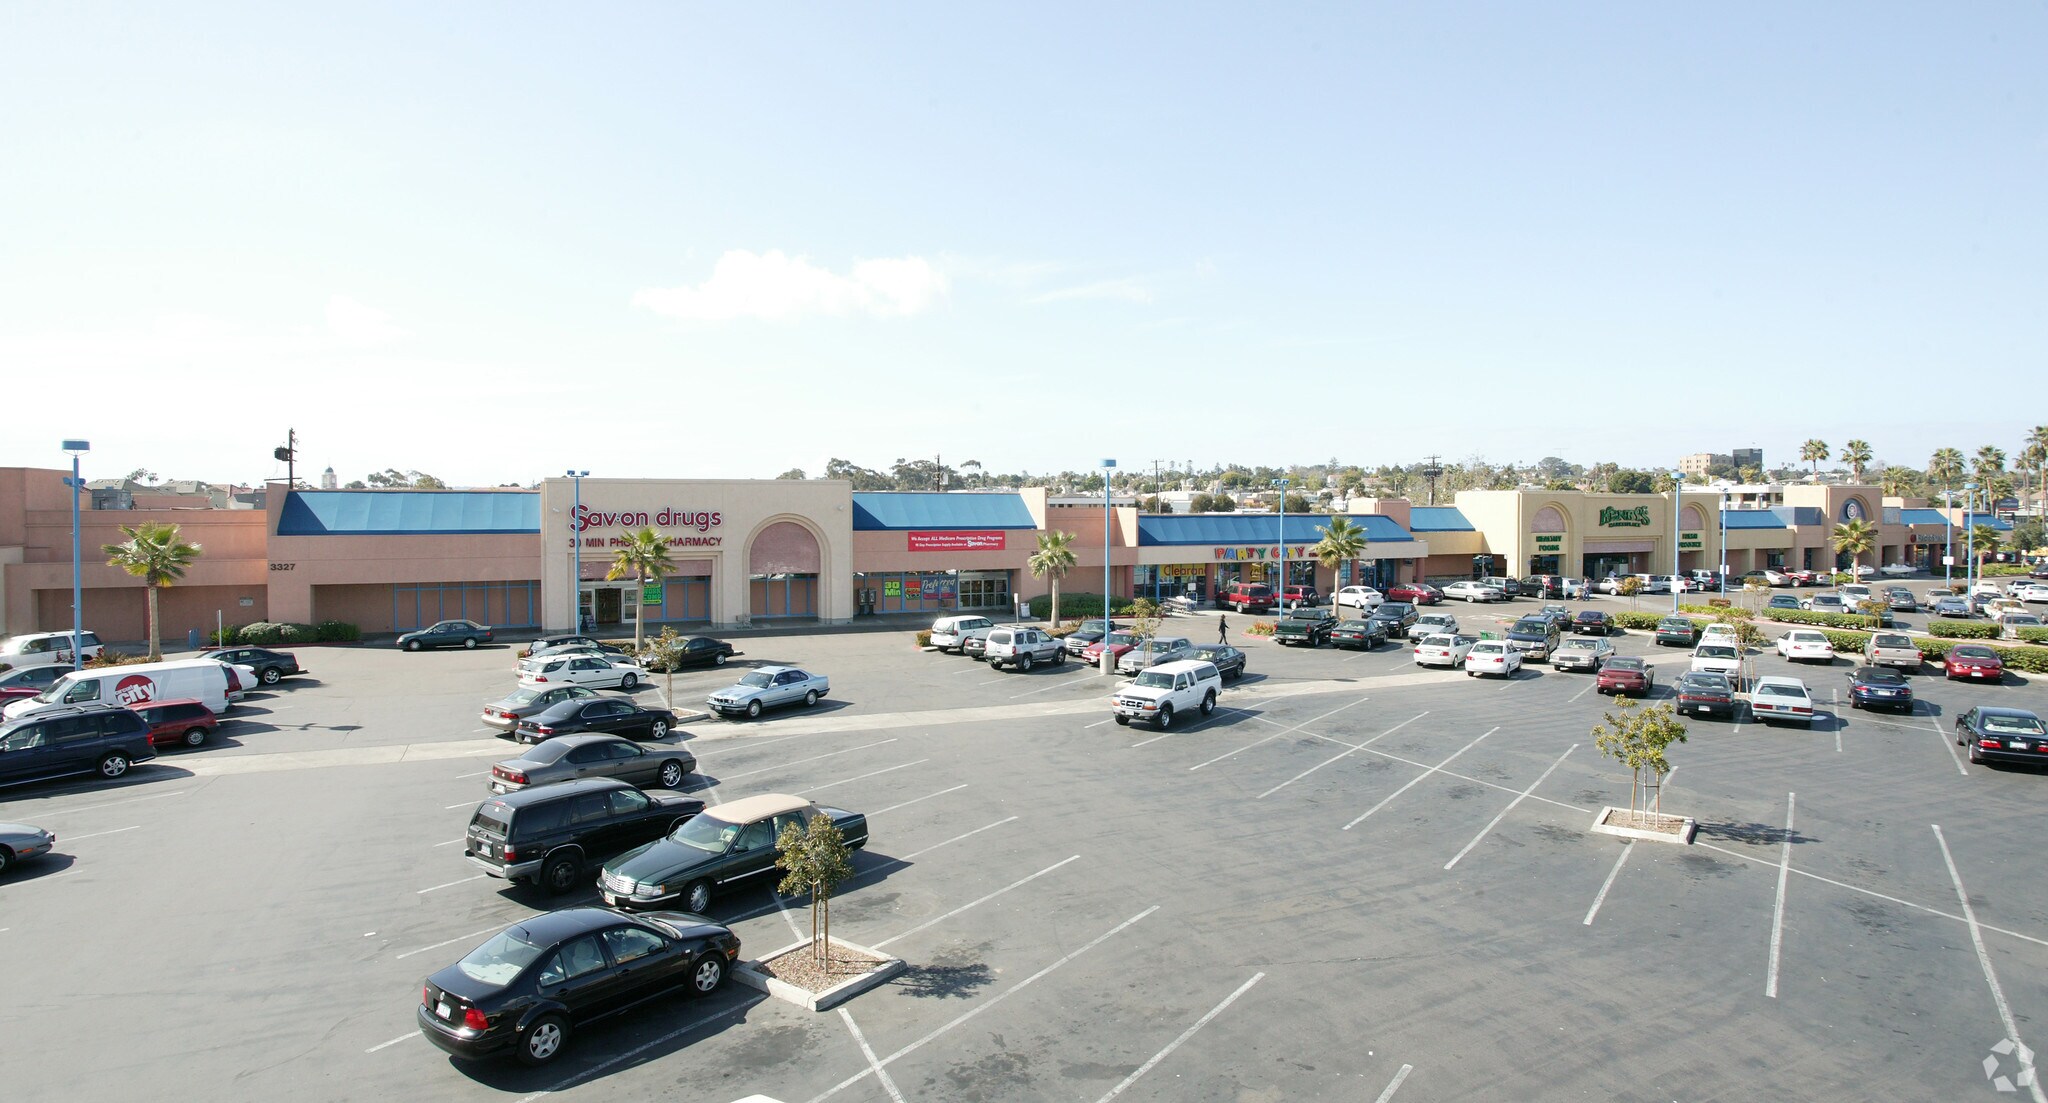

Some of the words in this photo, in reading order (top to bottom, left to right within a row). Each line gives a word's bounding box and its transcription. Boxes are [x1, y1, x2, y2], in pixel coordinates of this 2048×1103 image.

[655, 507, 722, 532] drugs
[586, 538, 605, 547] MIN
[610, 537, 637, 548] PHO
[1214, 547, 1267, 560] PARTY
[1271, 546, 1305, 559] CITY
[270, 563, 296, 571] 3327
[1164, 564, 1206, 576] Clearan
[885, 581, 900, 589] 30
[118, 682, 154, 706] city
